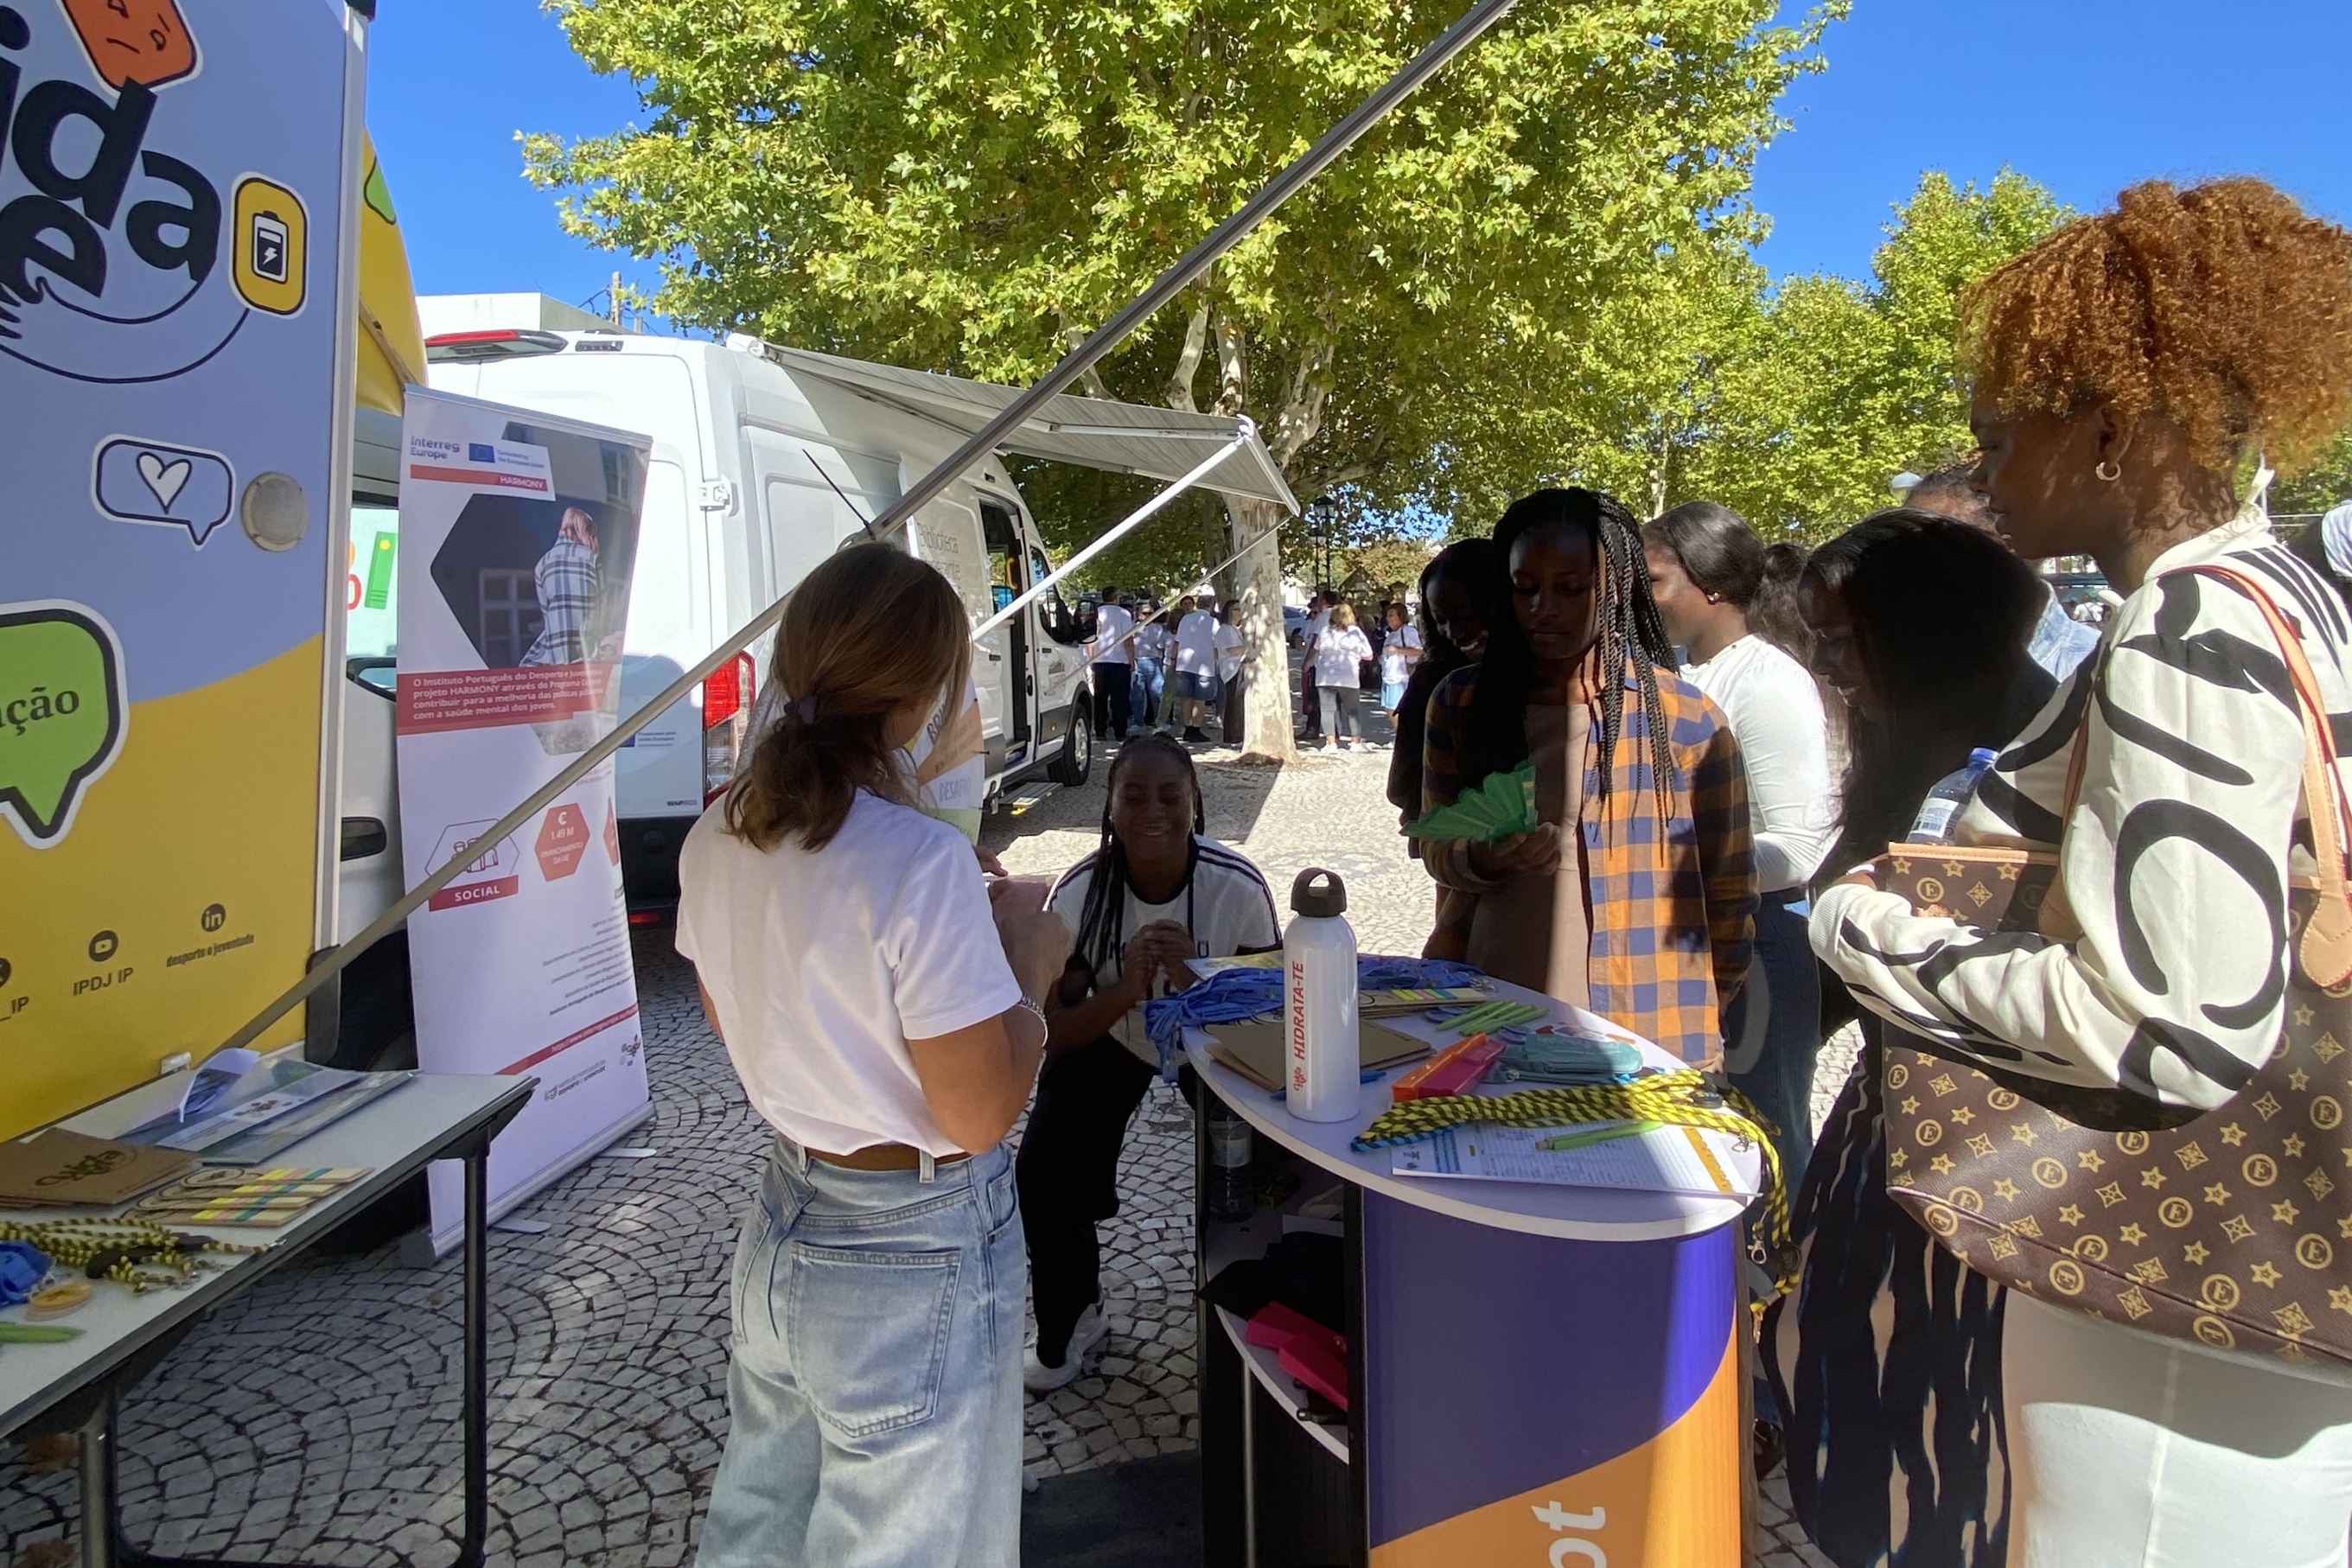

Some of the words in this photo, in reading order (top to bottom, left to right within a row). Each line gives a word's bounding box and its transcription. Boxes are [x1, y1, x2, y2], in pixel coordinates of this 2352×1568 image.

[411, 436, 460, 453] Interreg
[411, 447, 448, 460] Europe
[500, 476, 544, 488] HARMONY
[413, 679, 421, 687] O
[424, 677, 463, 686] Instituto
[465, 673, 513, 684] Português
[413, 689, 448, 700] projeto
[450, 685, 500, 695] HARMONY
[502, 682, 535, 692] através
[550, 679, 580, 690] Programa
[413, 698, 460, 710] contribuir
[462, 697, 485, 707] para
[494, 692, 536, 703] melhoria
[538, 691, 551, 699] das
[0, 686, 80, 736] ção
[413, 711, 435, 720] com
[444, 707, 474, 717] saúde
[475, 704, 509, 716] mental
[558, 811, 567, 825] €
[551, 829, 566, 840] 1.49
[566, 826, 574, 837] M
[540, 841, 584, 858] FINANCIAMENTO
[553, 856, 562, 864] DA
[455, 885, 500, 902] SOCIAL
[166, 947, 206, 967] desporto
[207, 947, 212, 955] e
[213, 934, 254, 956] juventude
[73, 972, 112, 996] IPDJ
[118, 966, 134, 984] IP
[1291, 960, 1305, 1060] HIDRATA-TE
